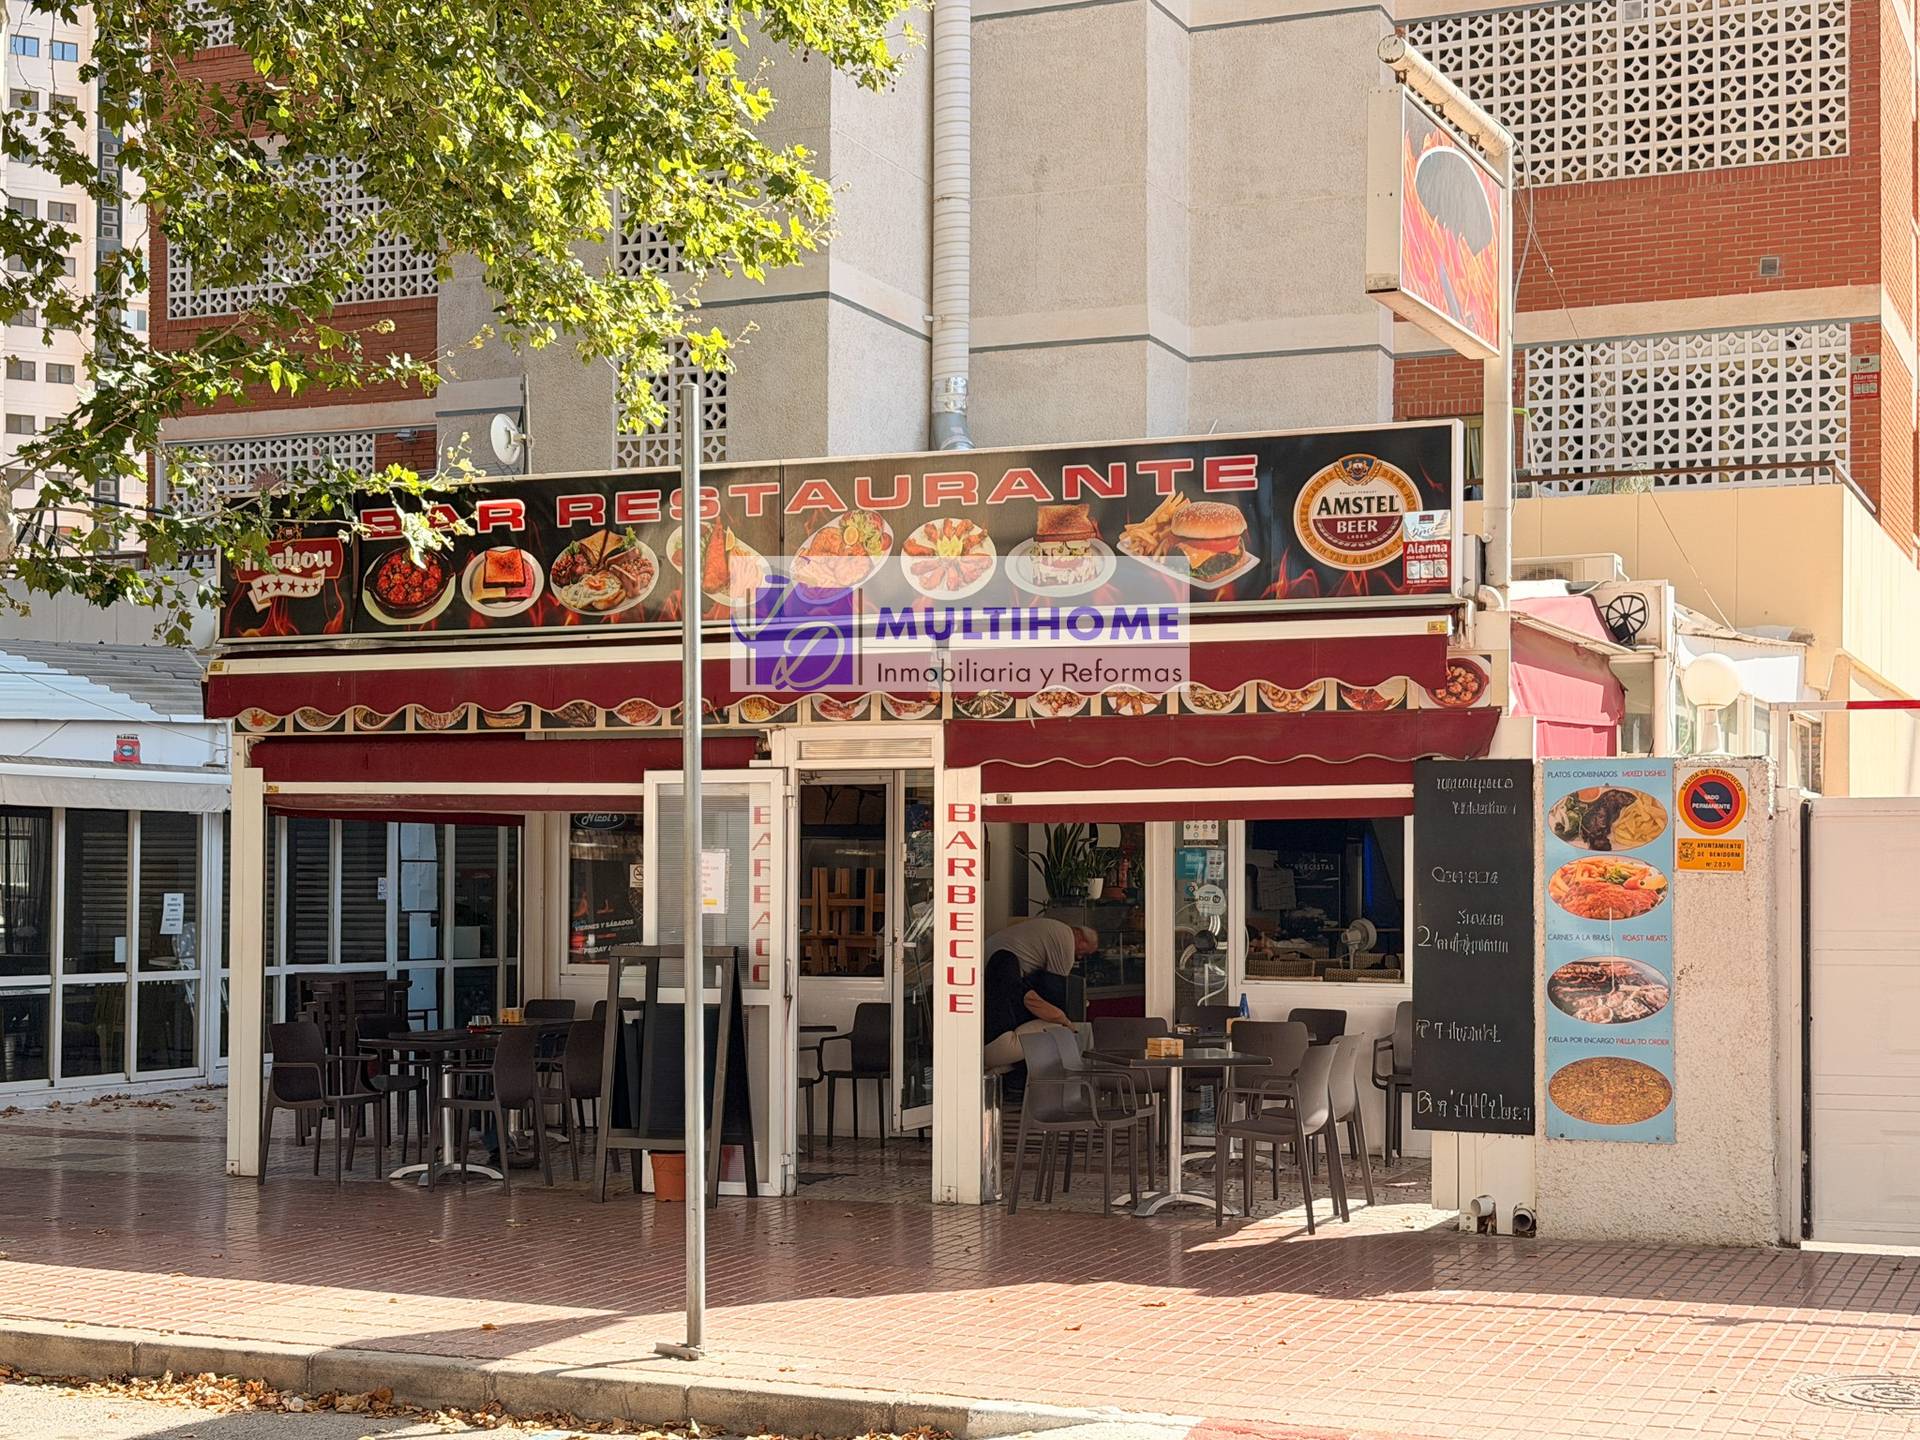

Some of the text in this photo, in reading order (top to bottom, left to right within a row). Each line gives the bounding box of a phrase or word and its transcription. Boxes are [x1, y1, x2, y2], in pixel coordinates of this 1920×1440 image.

[360, 499, 526, 542] BAR
[556, 454, 1258, 529] RESTAURANTE
[1317, 495, 1399, 516] AMSTEL
[1336, 519, 1379, 534] BEER
[1406, 542, 1449, 555] Alarma
[1572, 770, 1618, 778] COMBINADOS
[1680, 771, 1699, 790] SALIDA
[1700, 768, 1710, 776] DE
[581, 812, 618, 826] Nicols
[945, 803, 977, 1014] BARBECUE
